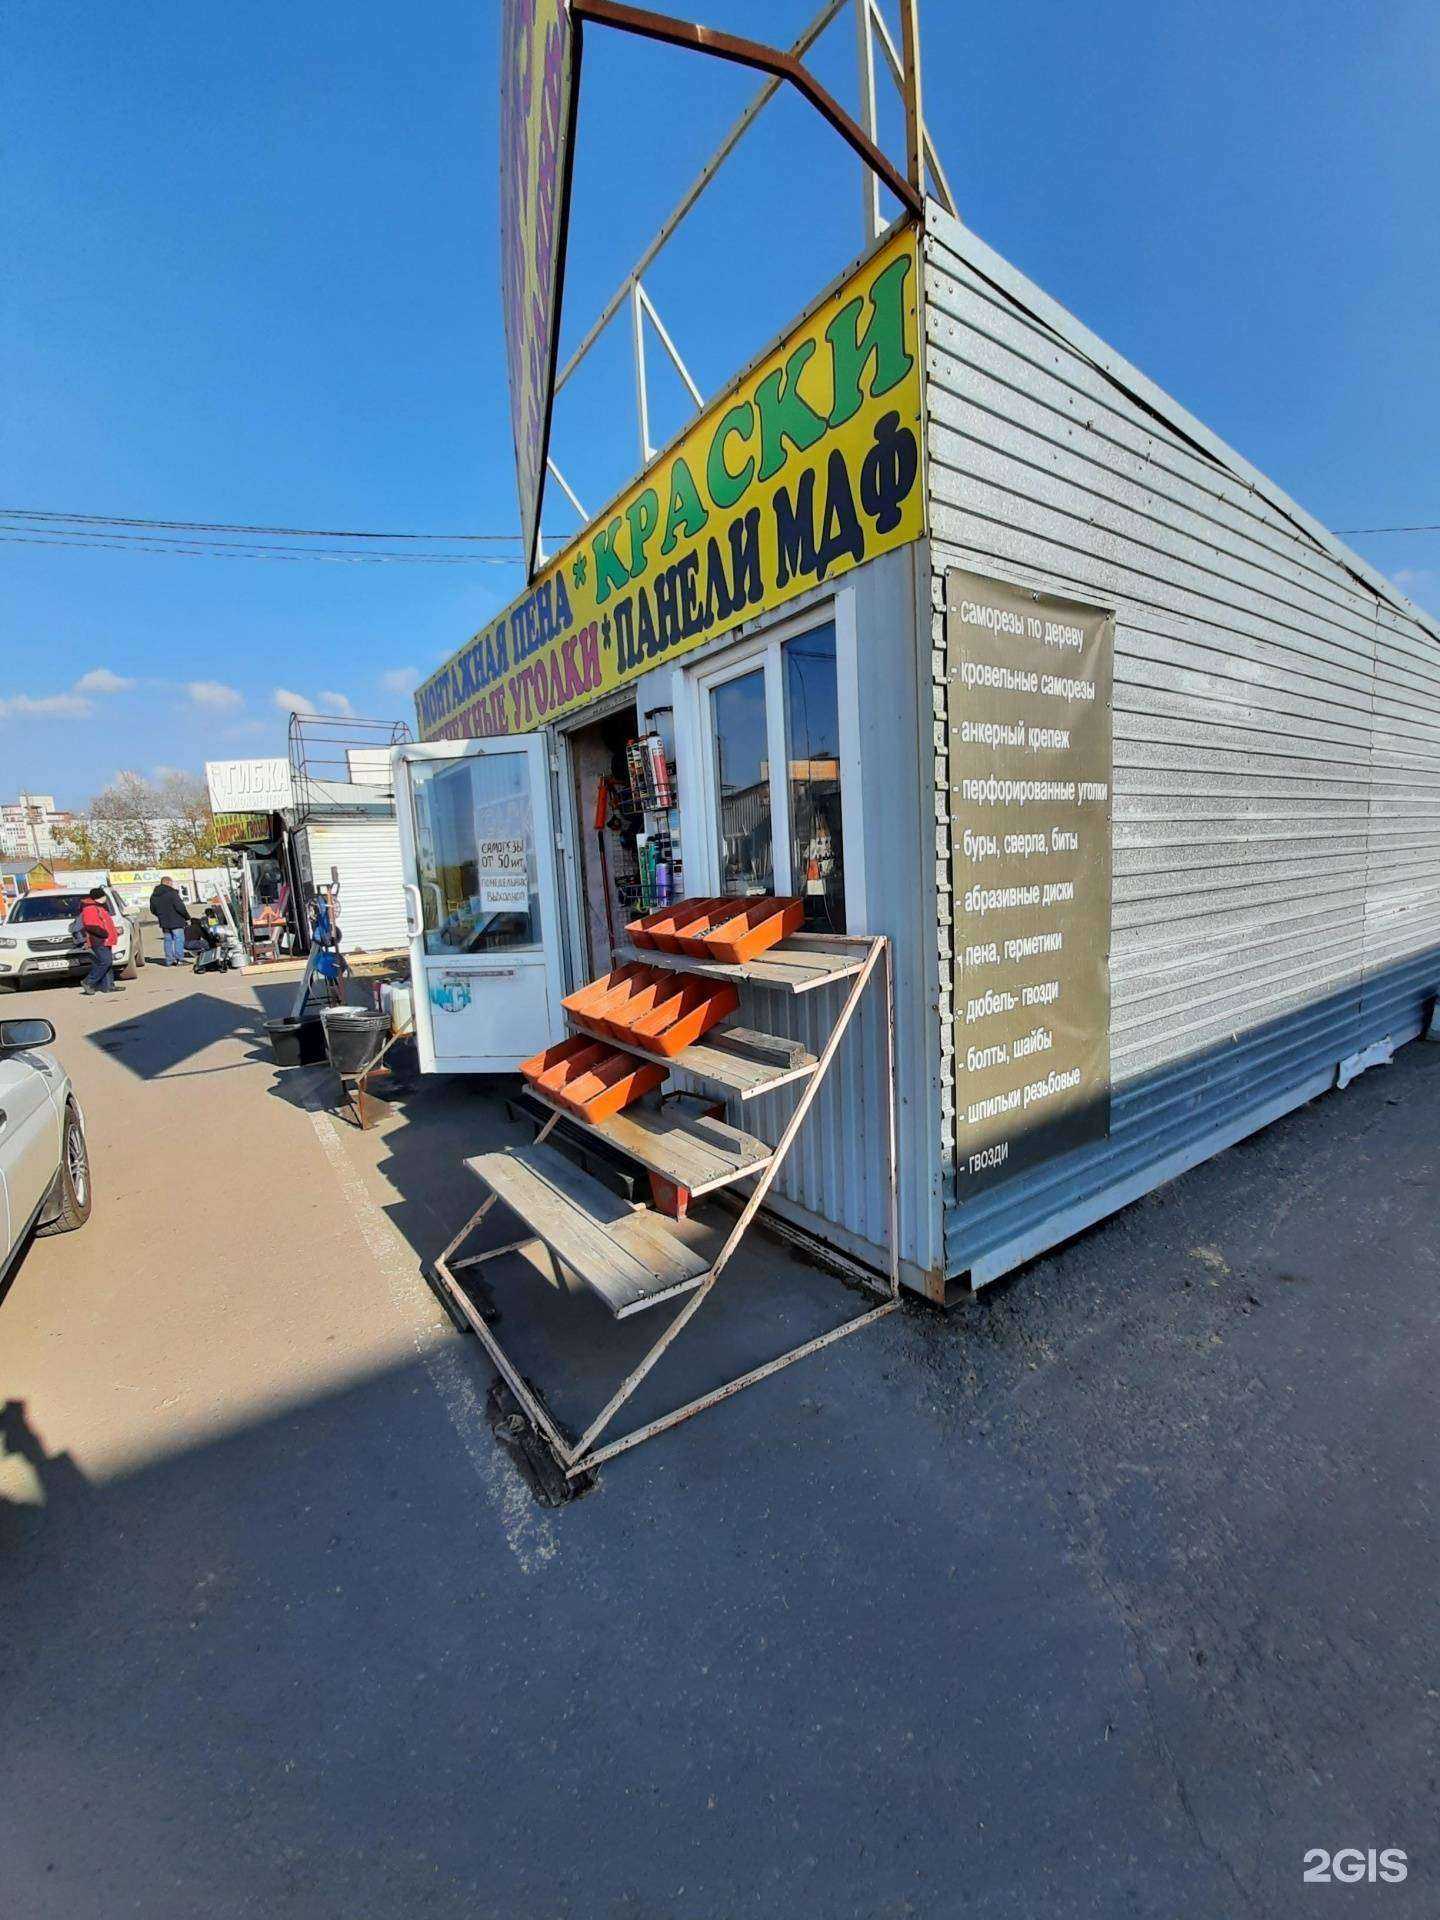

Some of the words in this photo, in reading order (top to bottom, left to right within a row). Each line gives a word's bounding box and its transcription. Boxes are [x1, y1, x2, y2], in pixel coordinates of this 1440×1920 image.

[419, 620, 510, 729] МОНТАЖНАЯ
[510, 569, 574, 666] ПЕНА
[592, 254, 914, 604] КРАСКИ
[508, 620, 603, 730] УГОЛКИ
[613, 508, 765, 675] ПАНЕЛИ
[772, 410, 918, 589] МДФ
[1027, 617, 1043, 639] по
[1044, 621, 1084, 653] дереву
[961, 661, 1039, 693] кровельные
[1040, 674, 1096, 703] саморезы
[961, 720, 1025, 750] анкерный
[1028, 727, 1070, 753] крепеж
[962, 774, 1075, 806] перфорированные
[1077, 780, 1108, 807] уголки
[963, 829, 1000, 864] буры,
[1003, 833, 1049, 858] сверла,
[1051, 826, 1078, 850] биты
[964, 883, 1041, 917] абразивные
[1042, 880, 1074, 904] диски
[966, 942, 1000, 966] пена,
[1004, 932, 1062, 962] герметики
[1021, 981, 1059, 1006] гвозди
[966, 1045, 1010, 1074] болты,
[1012, 1026, 1053, 1059] шайбы
[968, 1093, 1021, 1124] шпильки
[1024, 1066, 1081, 1107] резьбовые
[969, 1142, 1008, 1173] гвозди
